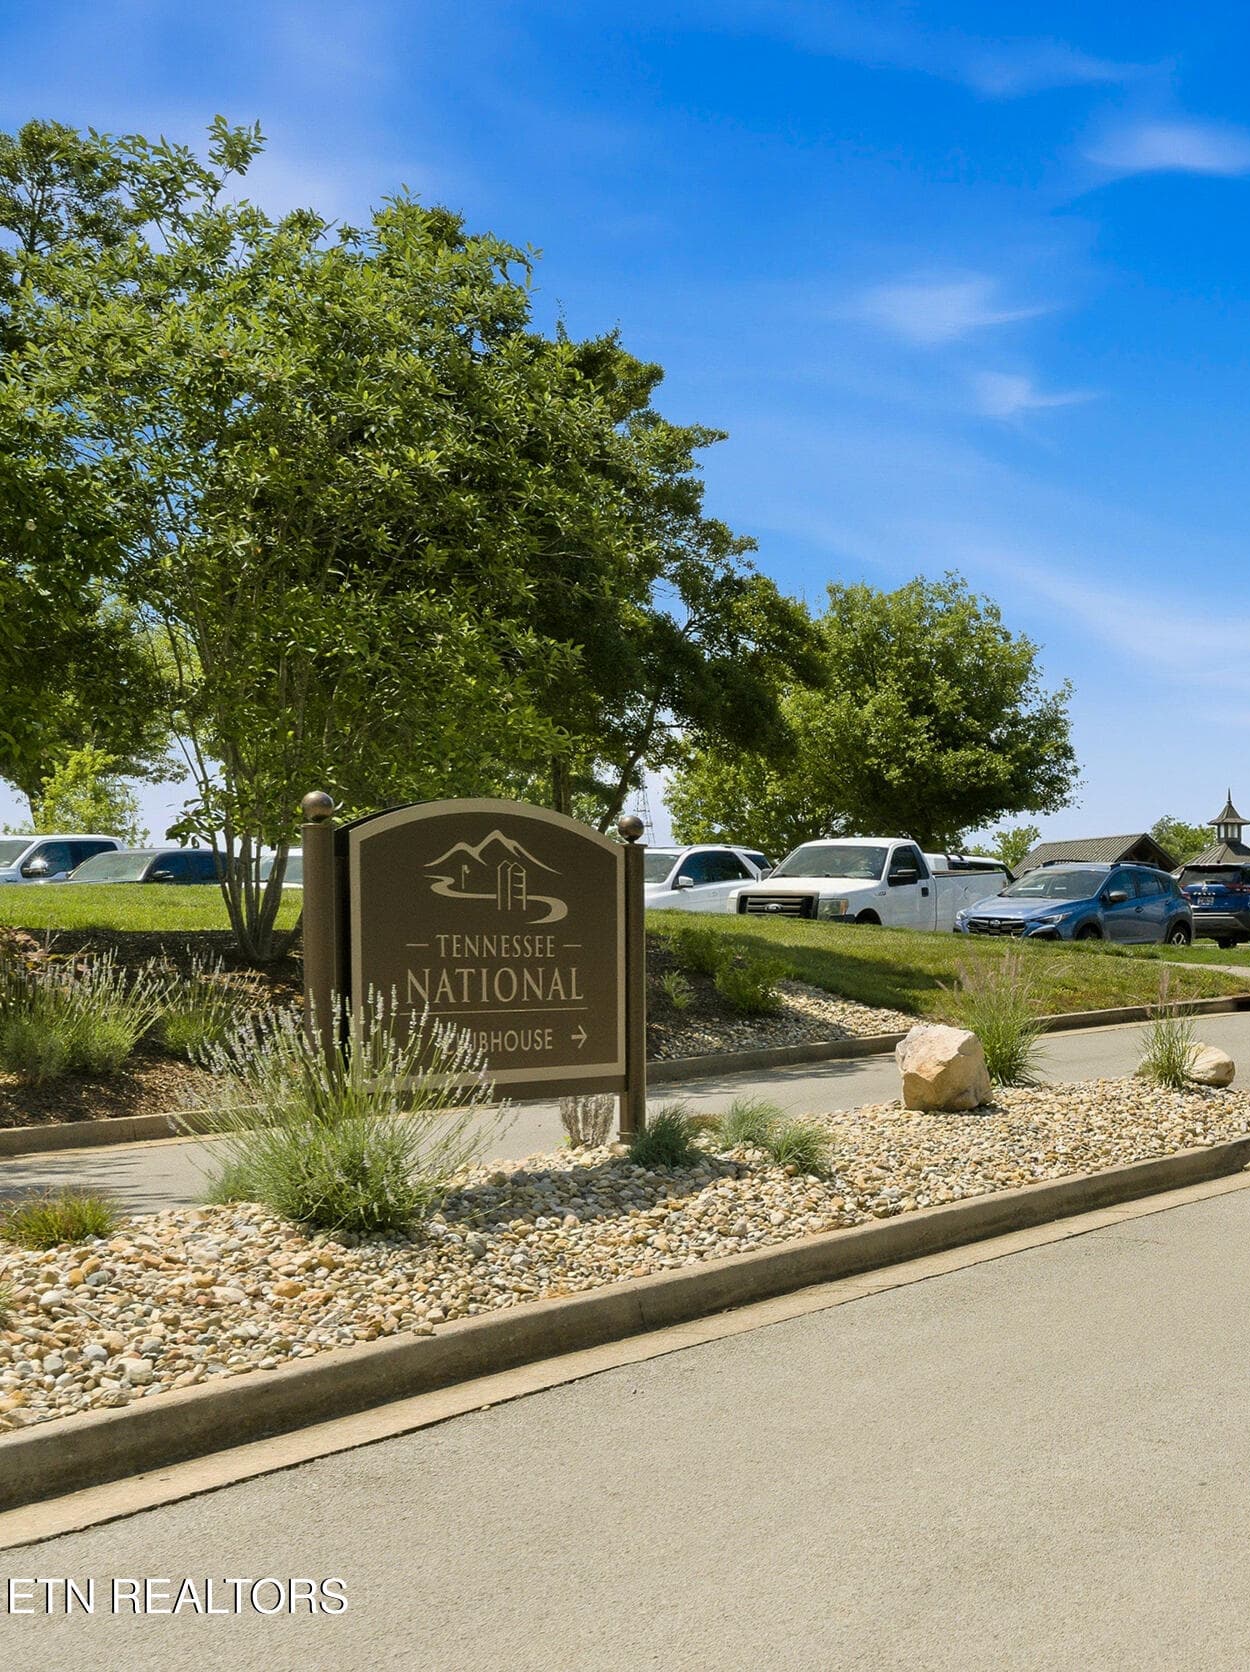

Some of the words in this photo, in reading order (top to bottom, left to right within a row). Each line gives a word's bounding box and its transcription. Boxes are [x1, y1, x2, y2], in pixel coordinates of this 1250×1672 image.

[436, 934, 556, 958] TENNESSEE
[405, 966, 585, 1004] NATIONAL
[443, 1028, 553, 1056] UBHOUSE
